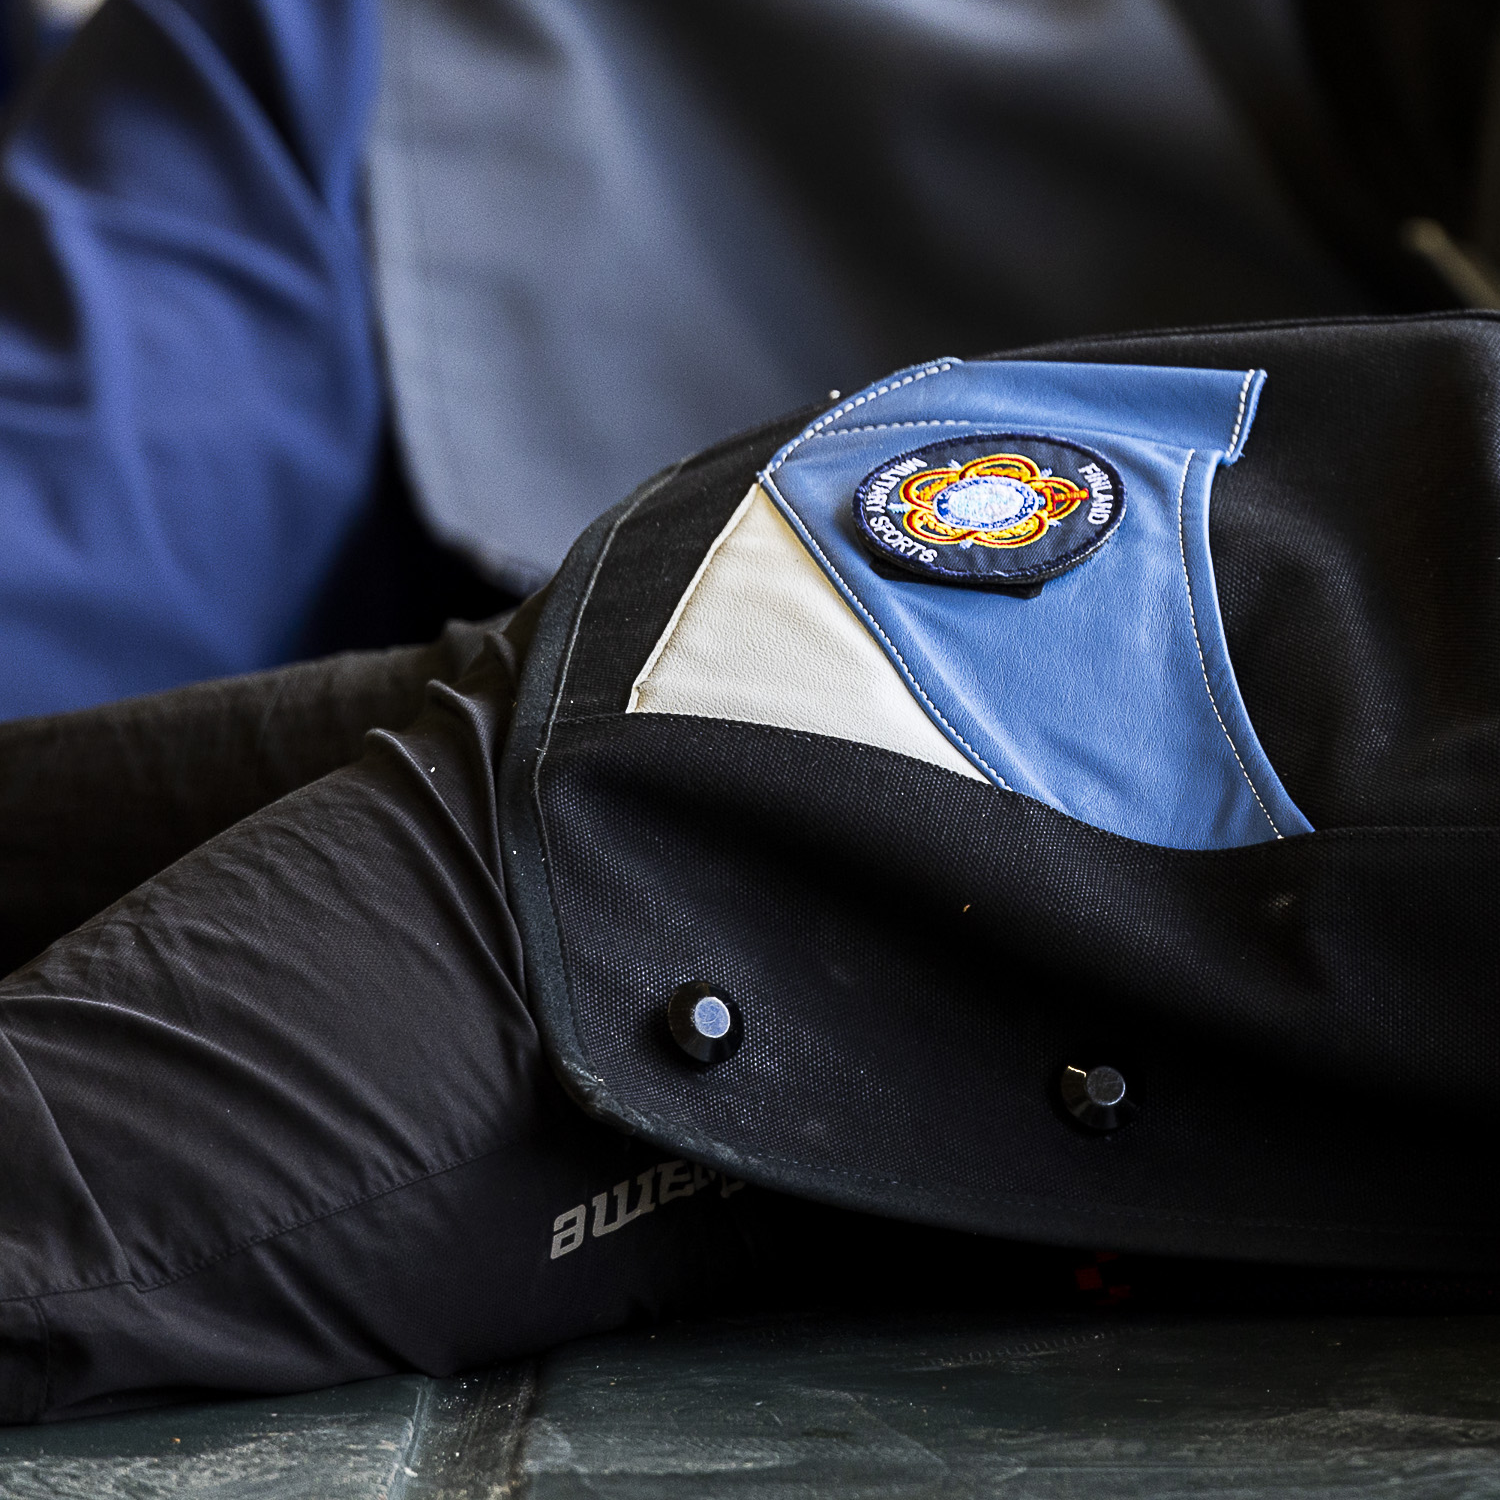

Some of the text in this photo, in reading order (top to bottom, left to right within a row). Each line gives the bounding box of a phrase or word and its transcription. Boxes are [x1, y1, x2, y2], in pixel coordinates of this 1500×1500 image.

[866, 457, 938, 563] MILITARY SPORTS
[1077, 462, 1114, 525] FINLAND
